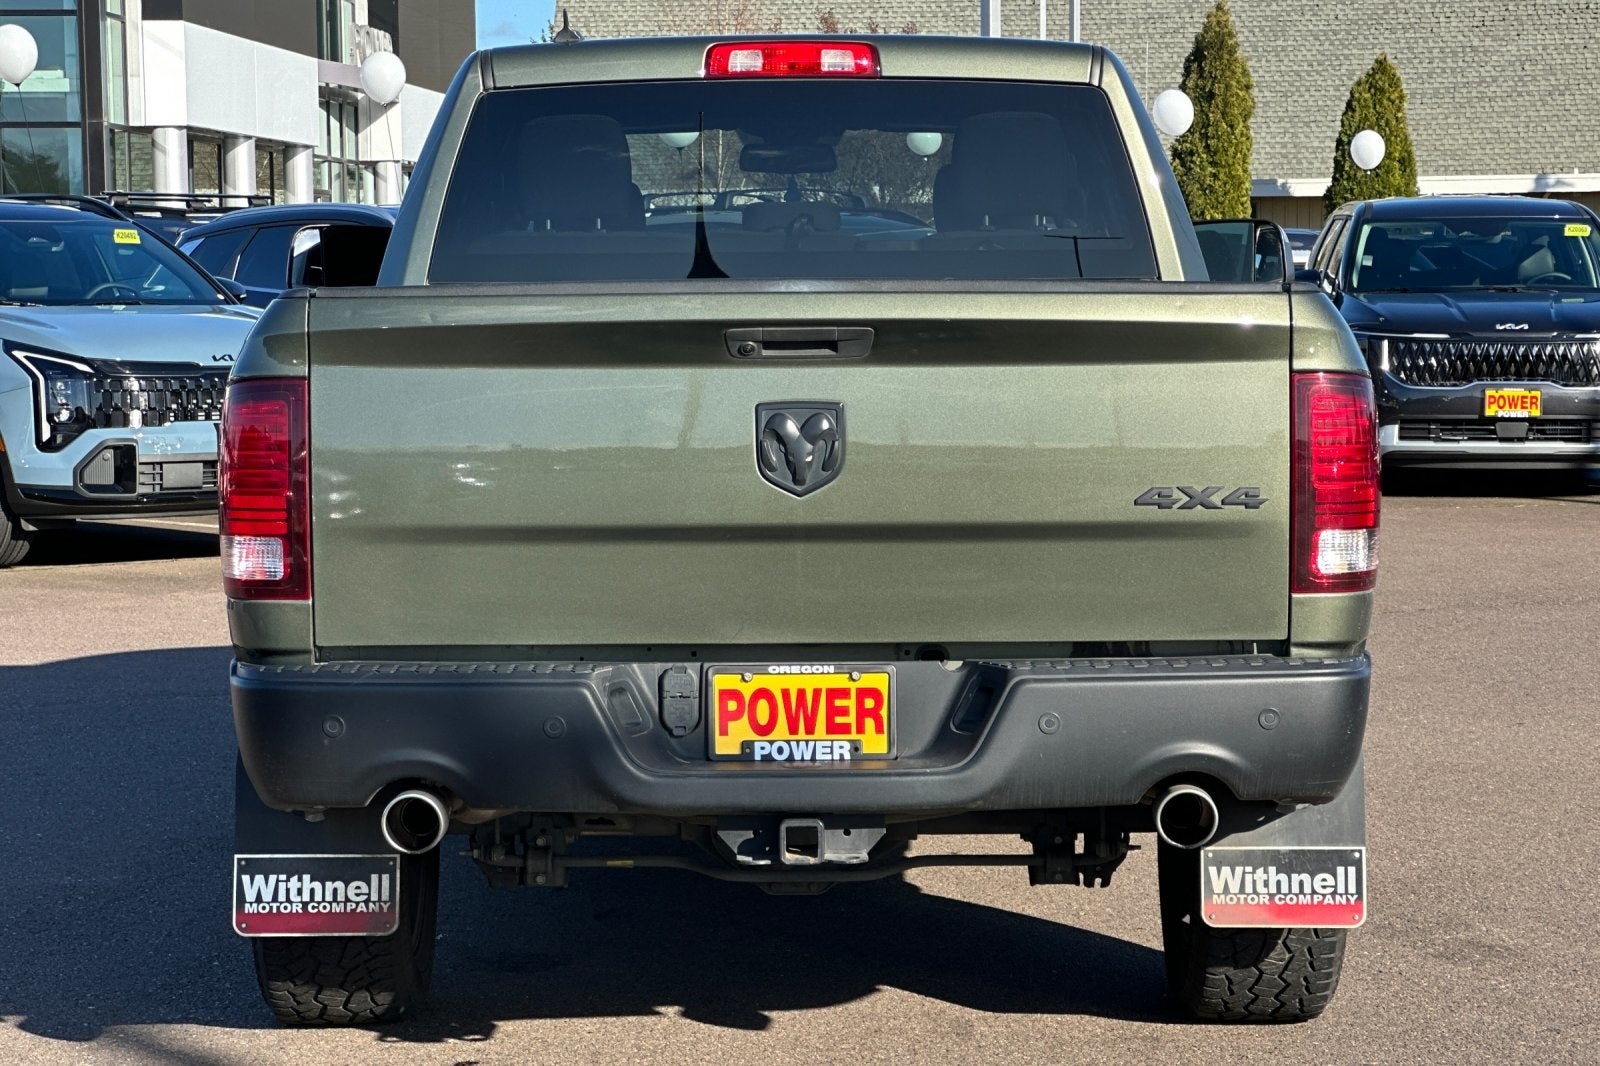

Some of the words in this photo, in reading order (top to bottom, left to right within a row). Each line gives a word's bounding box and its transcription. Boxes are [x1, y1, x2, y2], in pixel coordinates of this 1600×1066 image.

[1487, 395, 1539, 410] POWER
[1497, 410, 1529, 418] POWER
[1133, 486, 1271, 510] 4X4
[767, 665, 835, 674] OREGON
[718, 687, 885, 737] POWER
[754, 741, 851, 761] POWER
[241, 874, 390, 902] Withnell
[1208, 866, 1357, 894] Withnell
[244, 902, 303, 914] MOTOR
[307, 902, 391, 913] COMPANY
[1212, 894, 1271, 905] MOTOR
[1274, 894, 1359, 905] COMPANY
